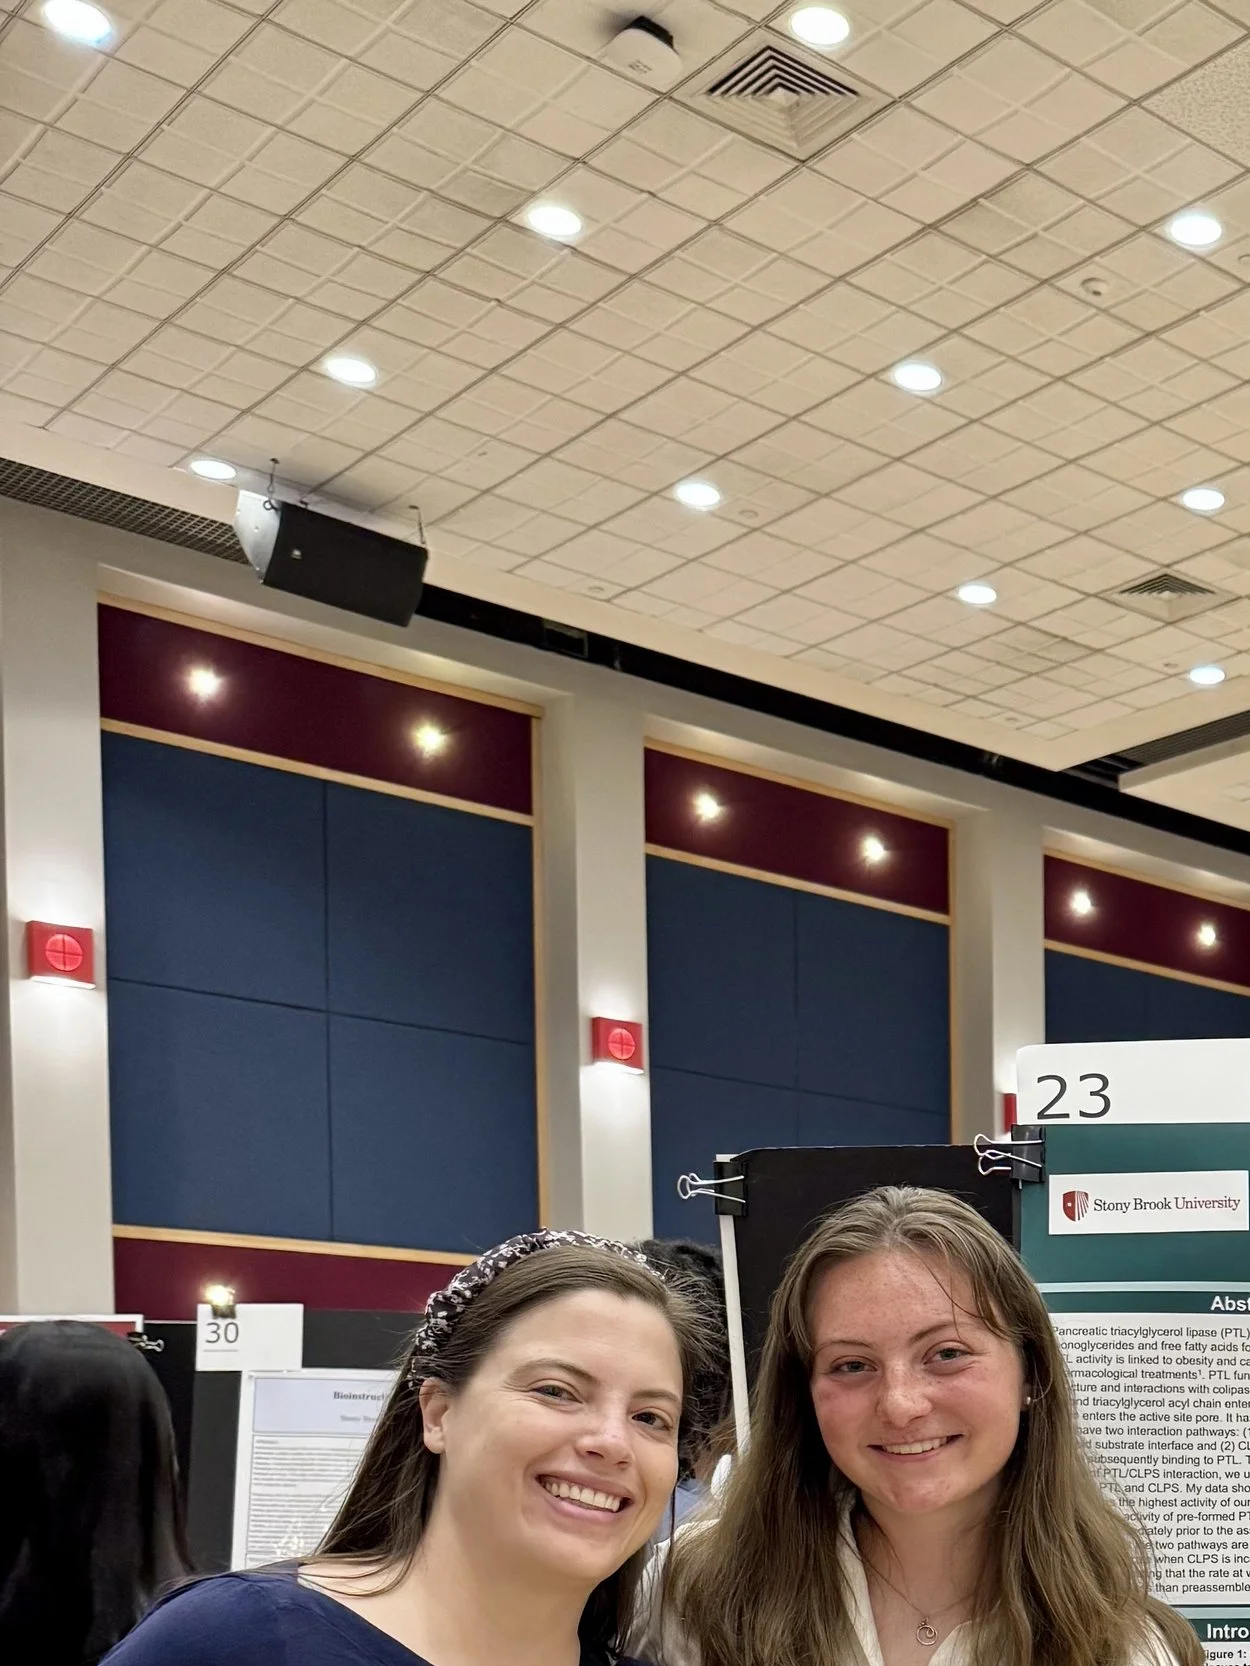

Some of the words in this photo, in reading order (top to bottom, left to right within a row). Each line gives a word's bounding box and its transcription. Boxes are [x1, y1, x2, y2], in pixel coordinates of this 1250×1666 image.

[1035, 1073, 1112, 1120] 23
[1094, 1198, 1130, 1213] Stony
[1133, 1197, 1171, 1209] Brook
[1174, 1196, 1240, 1210] University
[205, 1322, 239, 1344] 30
[1111, 1326, 1182, 1338] triacylglycerol
[1186, 1327, 1217, 1338] lipase
[1221, 1328, 1250, 1339] (PTL)
[1155, 1582, 1178, 1594] than
